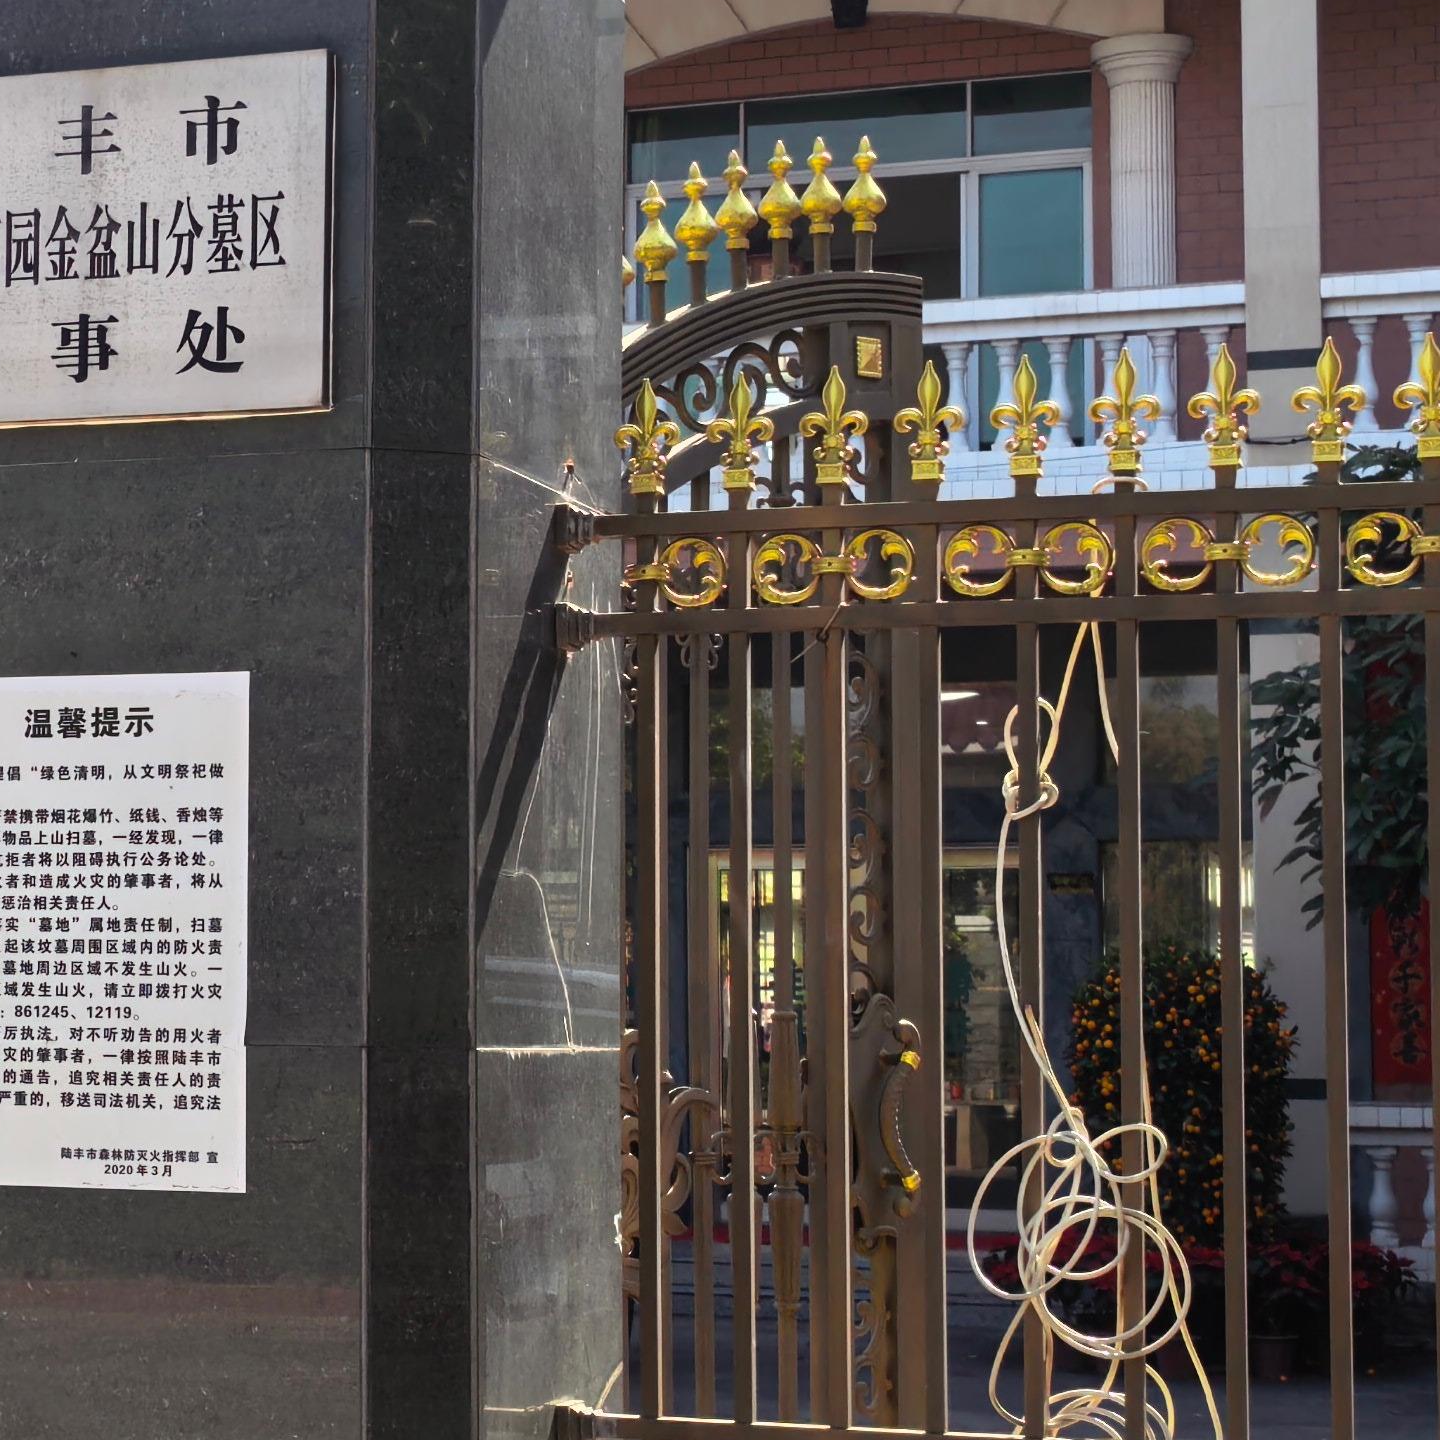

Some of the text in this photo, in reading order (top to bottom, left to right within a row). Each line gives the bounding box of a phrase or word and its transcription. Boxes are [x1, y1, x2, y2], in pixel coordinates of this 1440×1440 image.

[24, 706, 155, 739] 温馨提示
[60, 1147, 220, 1165] 陆丰市森林防灭火指挥部 宣
